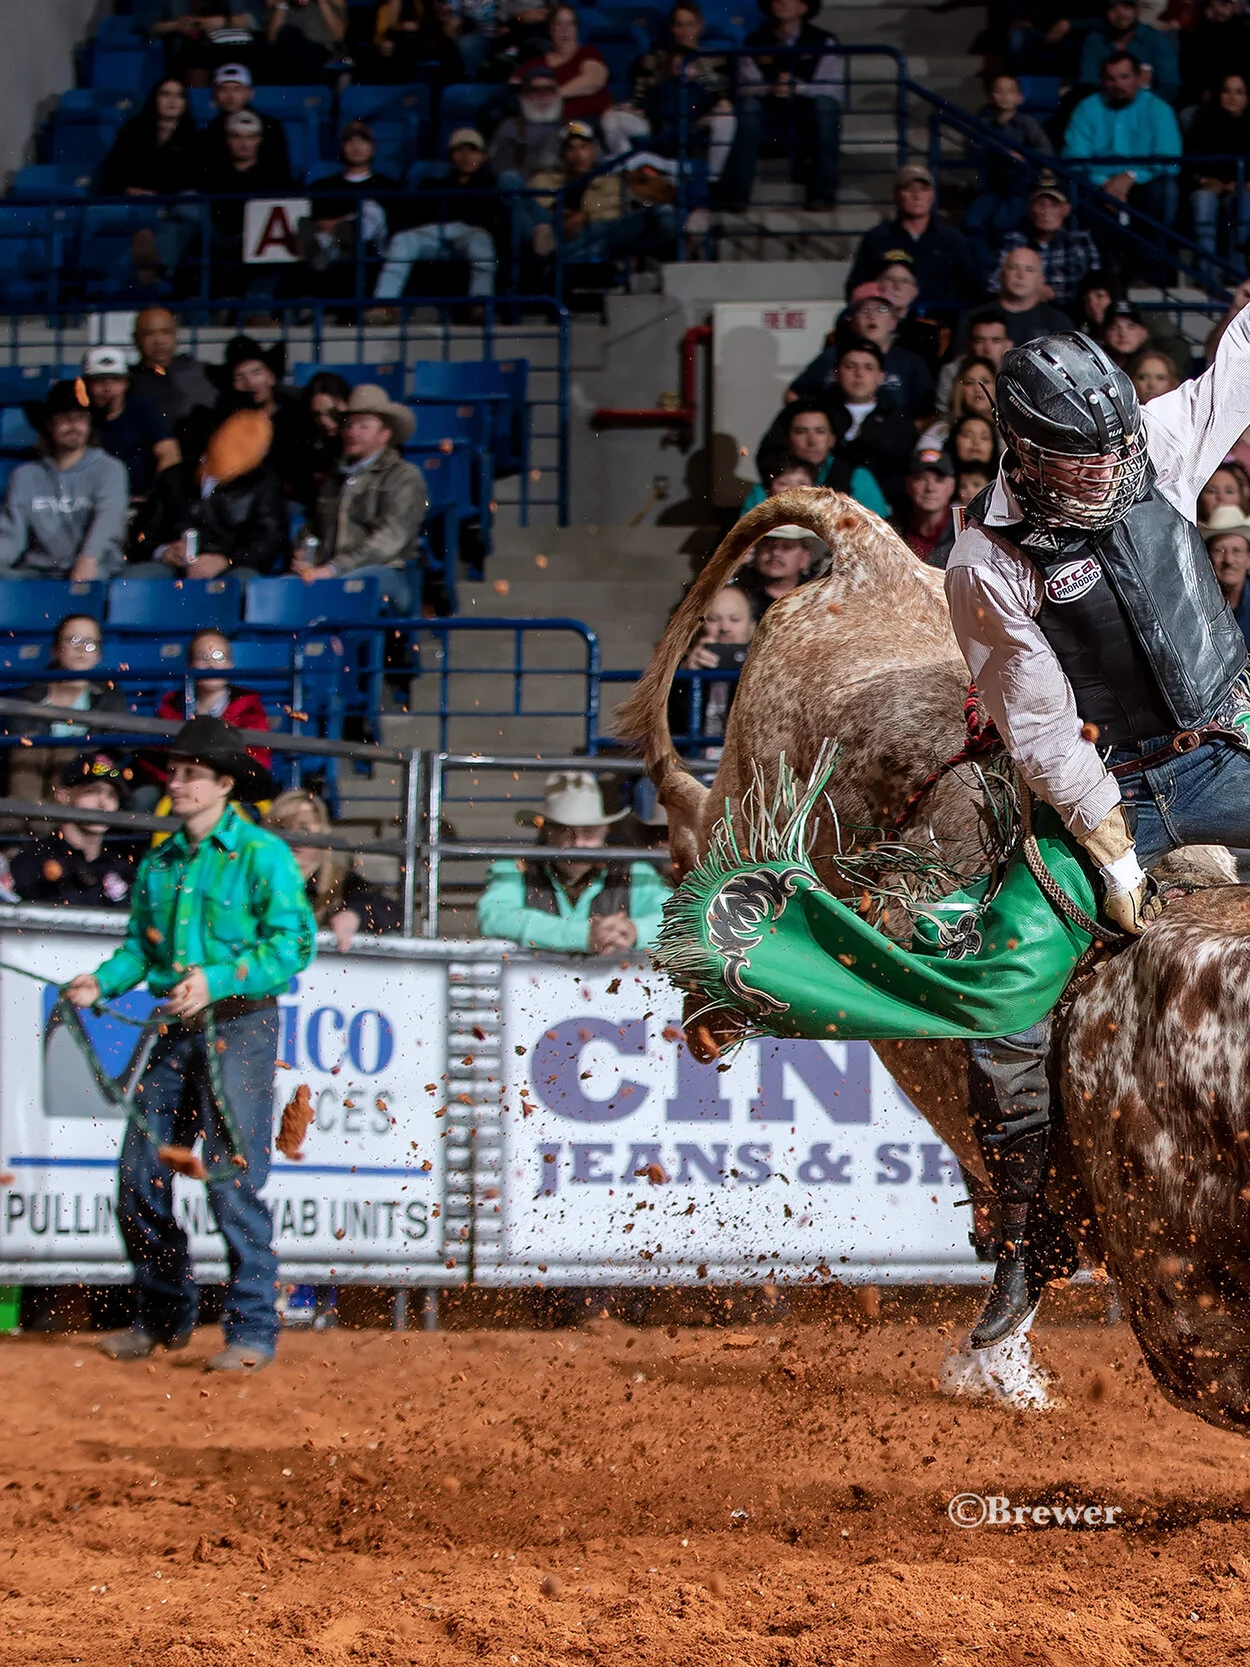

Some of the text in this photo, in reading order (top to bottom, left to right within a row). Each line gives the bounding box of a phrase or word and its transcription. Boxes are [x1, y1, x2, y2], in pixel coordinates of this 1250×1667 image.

[253, 205, 304, 258] A
[1047, 559, 1096, 600] prca
[1056, 571, 1100, 599] PRORODEO
[279, 975, 395, 1076] ico
[530, 1016, 930, 1124] CIN
[534, 1142, 969, 1197] JEANS & SH
[331, 1198, 429, 1240] UNITS
